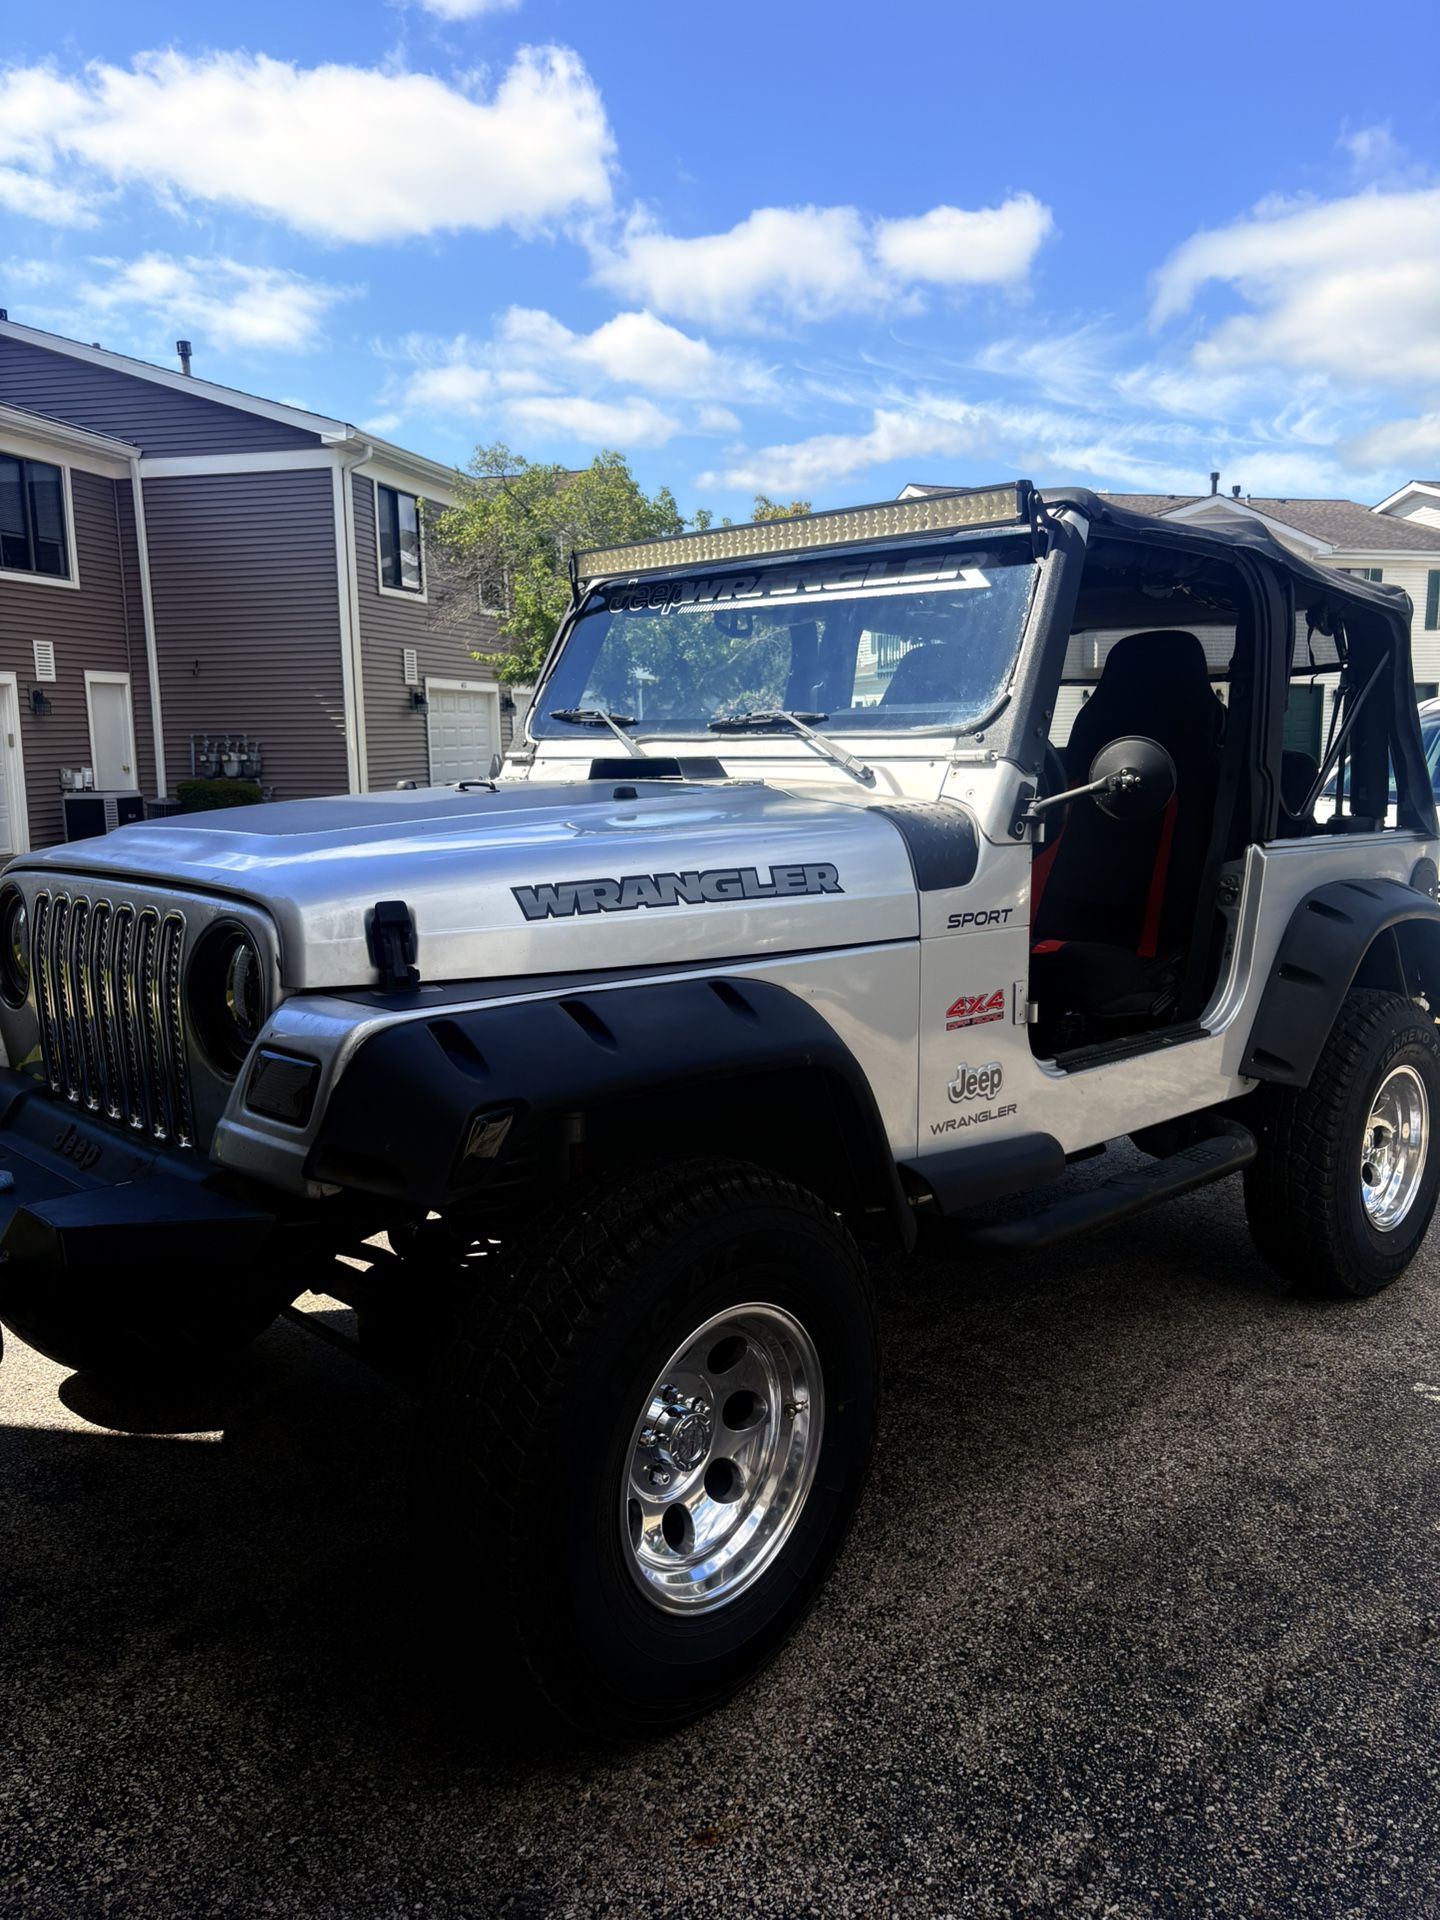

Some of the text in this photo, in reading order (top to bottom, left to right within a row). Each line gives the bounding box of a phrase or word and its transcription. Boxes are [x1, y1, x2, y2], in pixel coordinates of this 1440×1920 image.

[608, 551, 989, 615] Jeep WRANGLER
[510, 862, 846, 921] WRANGLER
[946, 908, 1013, 929] SPORT
[949, 1062, 1004, 1104] Jeep
[930, 1103, 1017, 1136] WRANGLER
[53, 1122, 103, 1172] Jeep
